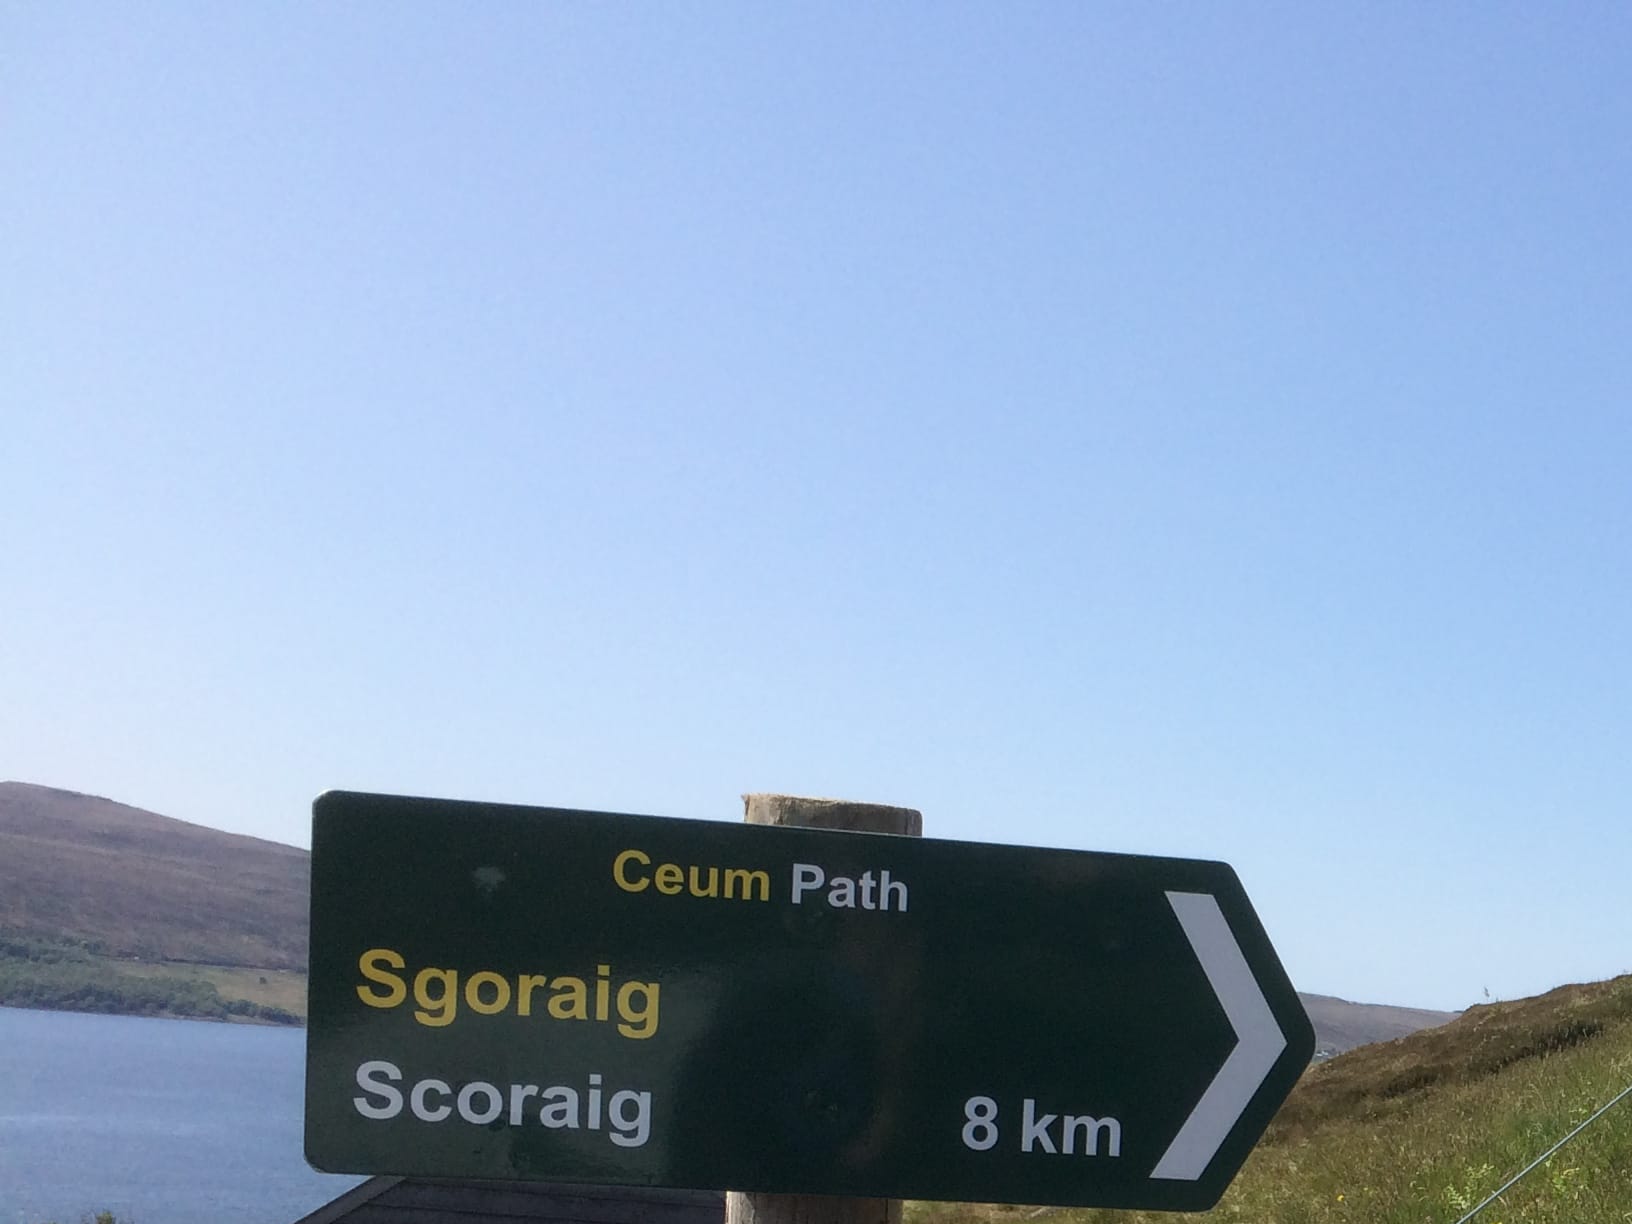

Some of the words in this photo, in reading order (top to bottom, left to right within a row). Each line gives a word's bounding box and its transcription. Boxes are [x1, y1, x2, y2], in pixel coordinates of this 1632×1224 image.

[611, 848, 770, 902] Ceum
[790, 862, 910, 912] Path
[355, 948, 662, 1040] Sgoraig
[352, 1060, 653, 1147] Scoraig
[962, 1095, 999, 1151] 8
[1021, 1098, 1122, 1158] km
